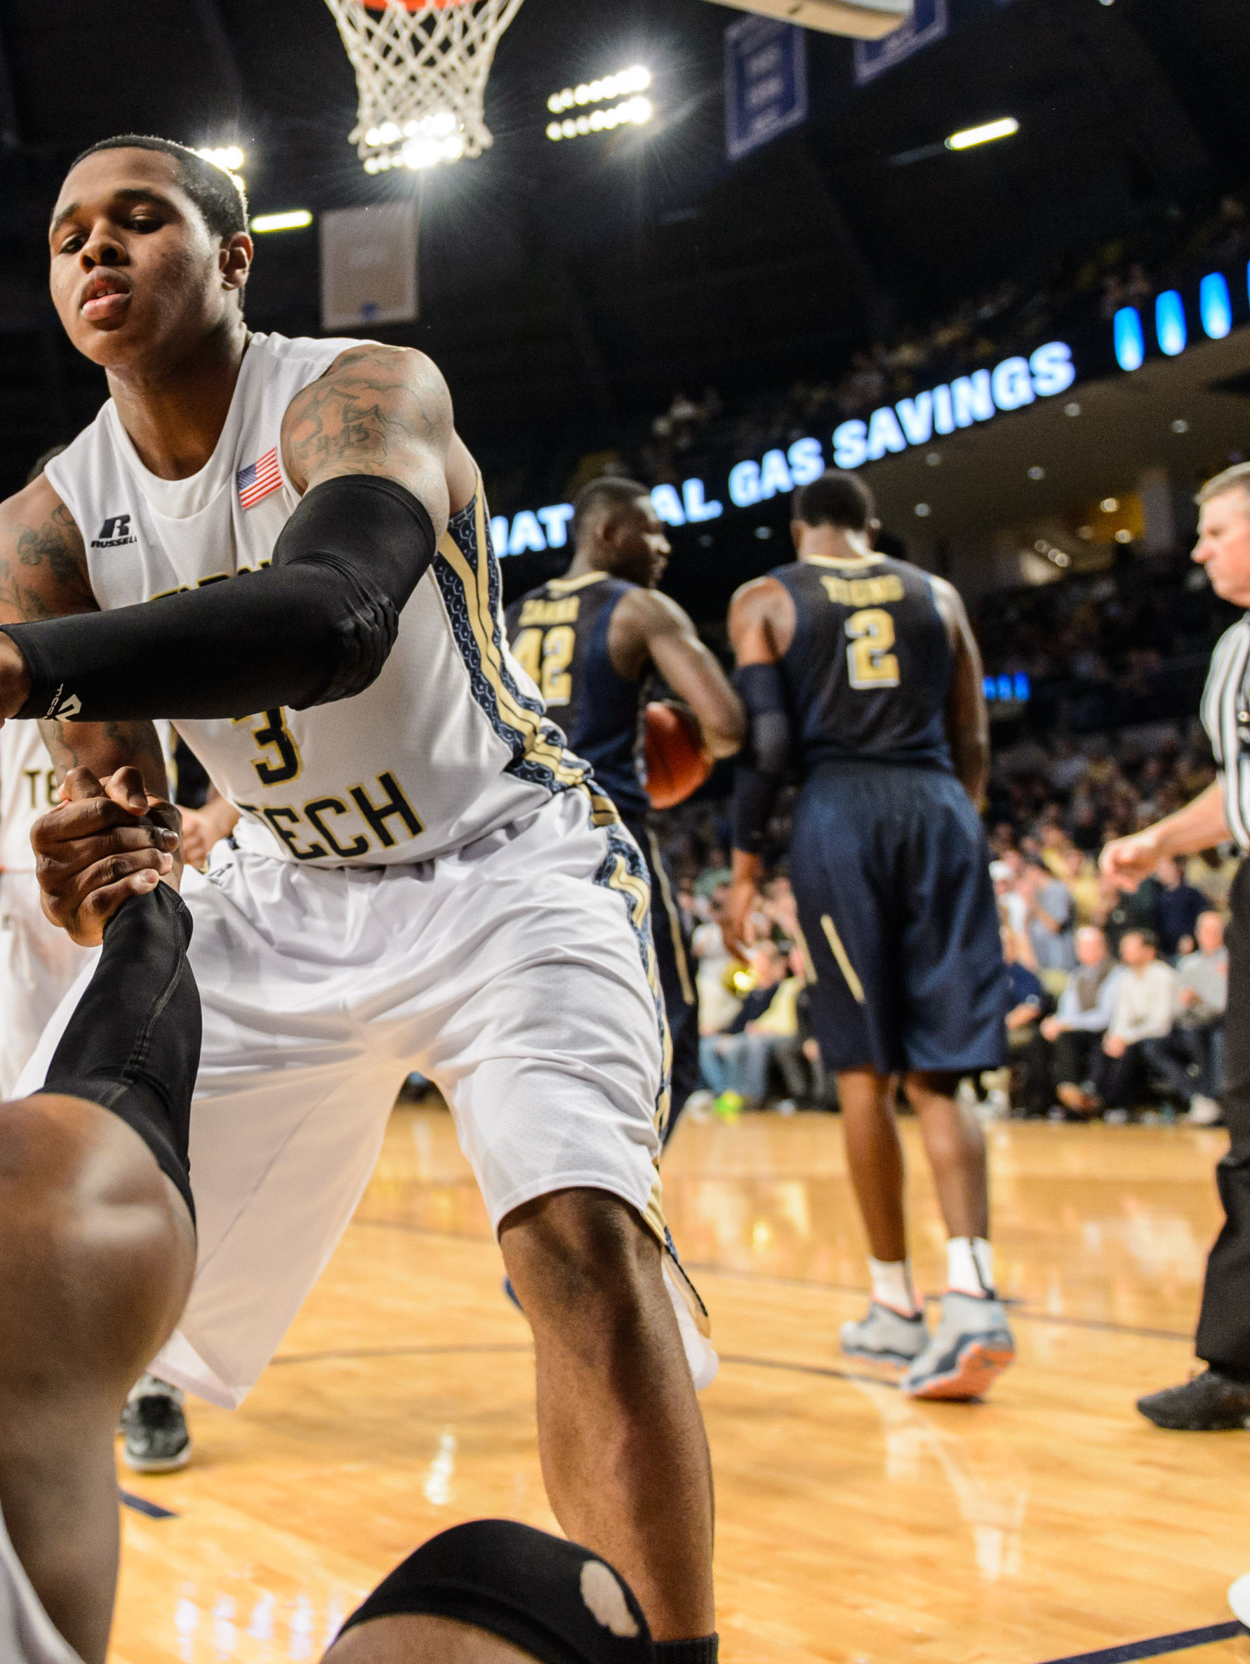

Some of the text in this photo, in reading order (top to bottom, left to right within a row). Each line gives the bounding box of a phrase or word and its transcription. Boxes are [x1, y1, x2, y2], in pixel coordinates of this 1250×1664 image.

[728, 437, 825, 508] GAS
[832, 341, 1076, 470] SAVINGS
[510, 625, 576, 706] 42
[844, 608, 900, 690] 2
[231, 705, 303, 789] 3
[23, 768, 63, 809] TE
